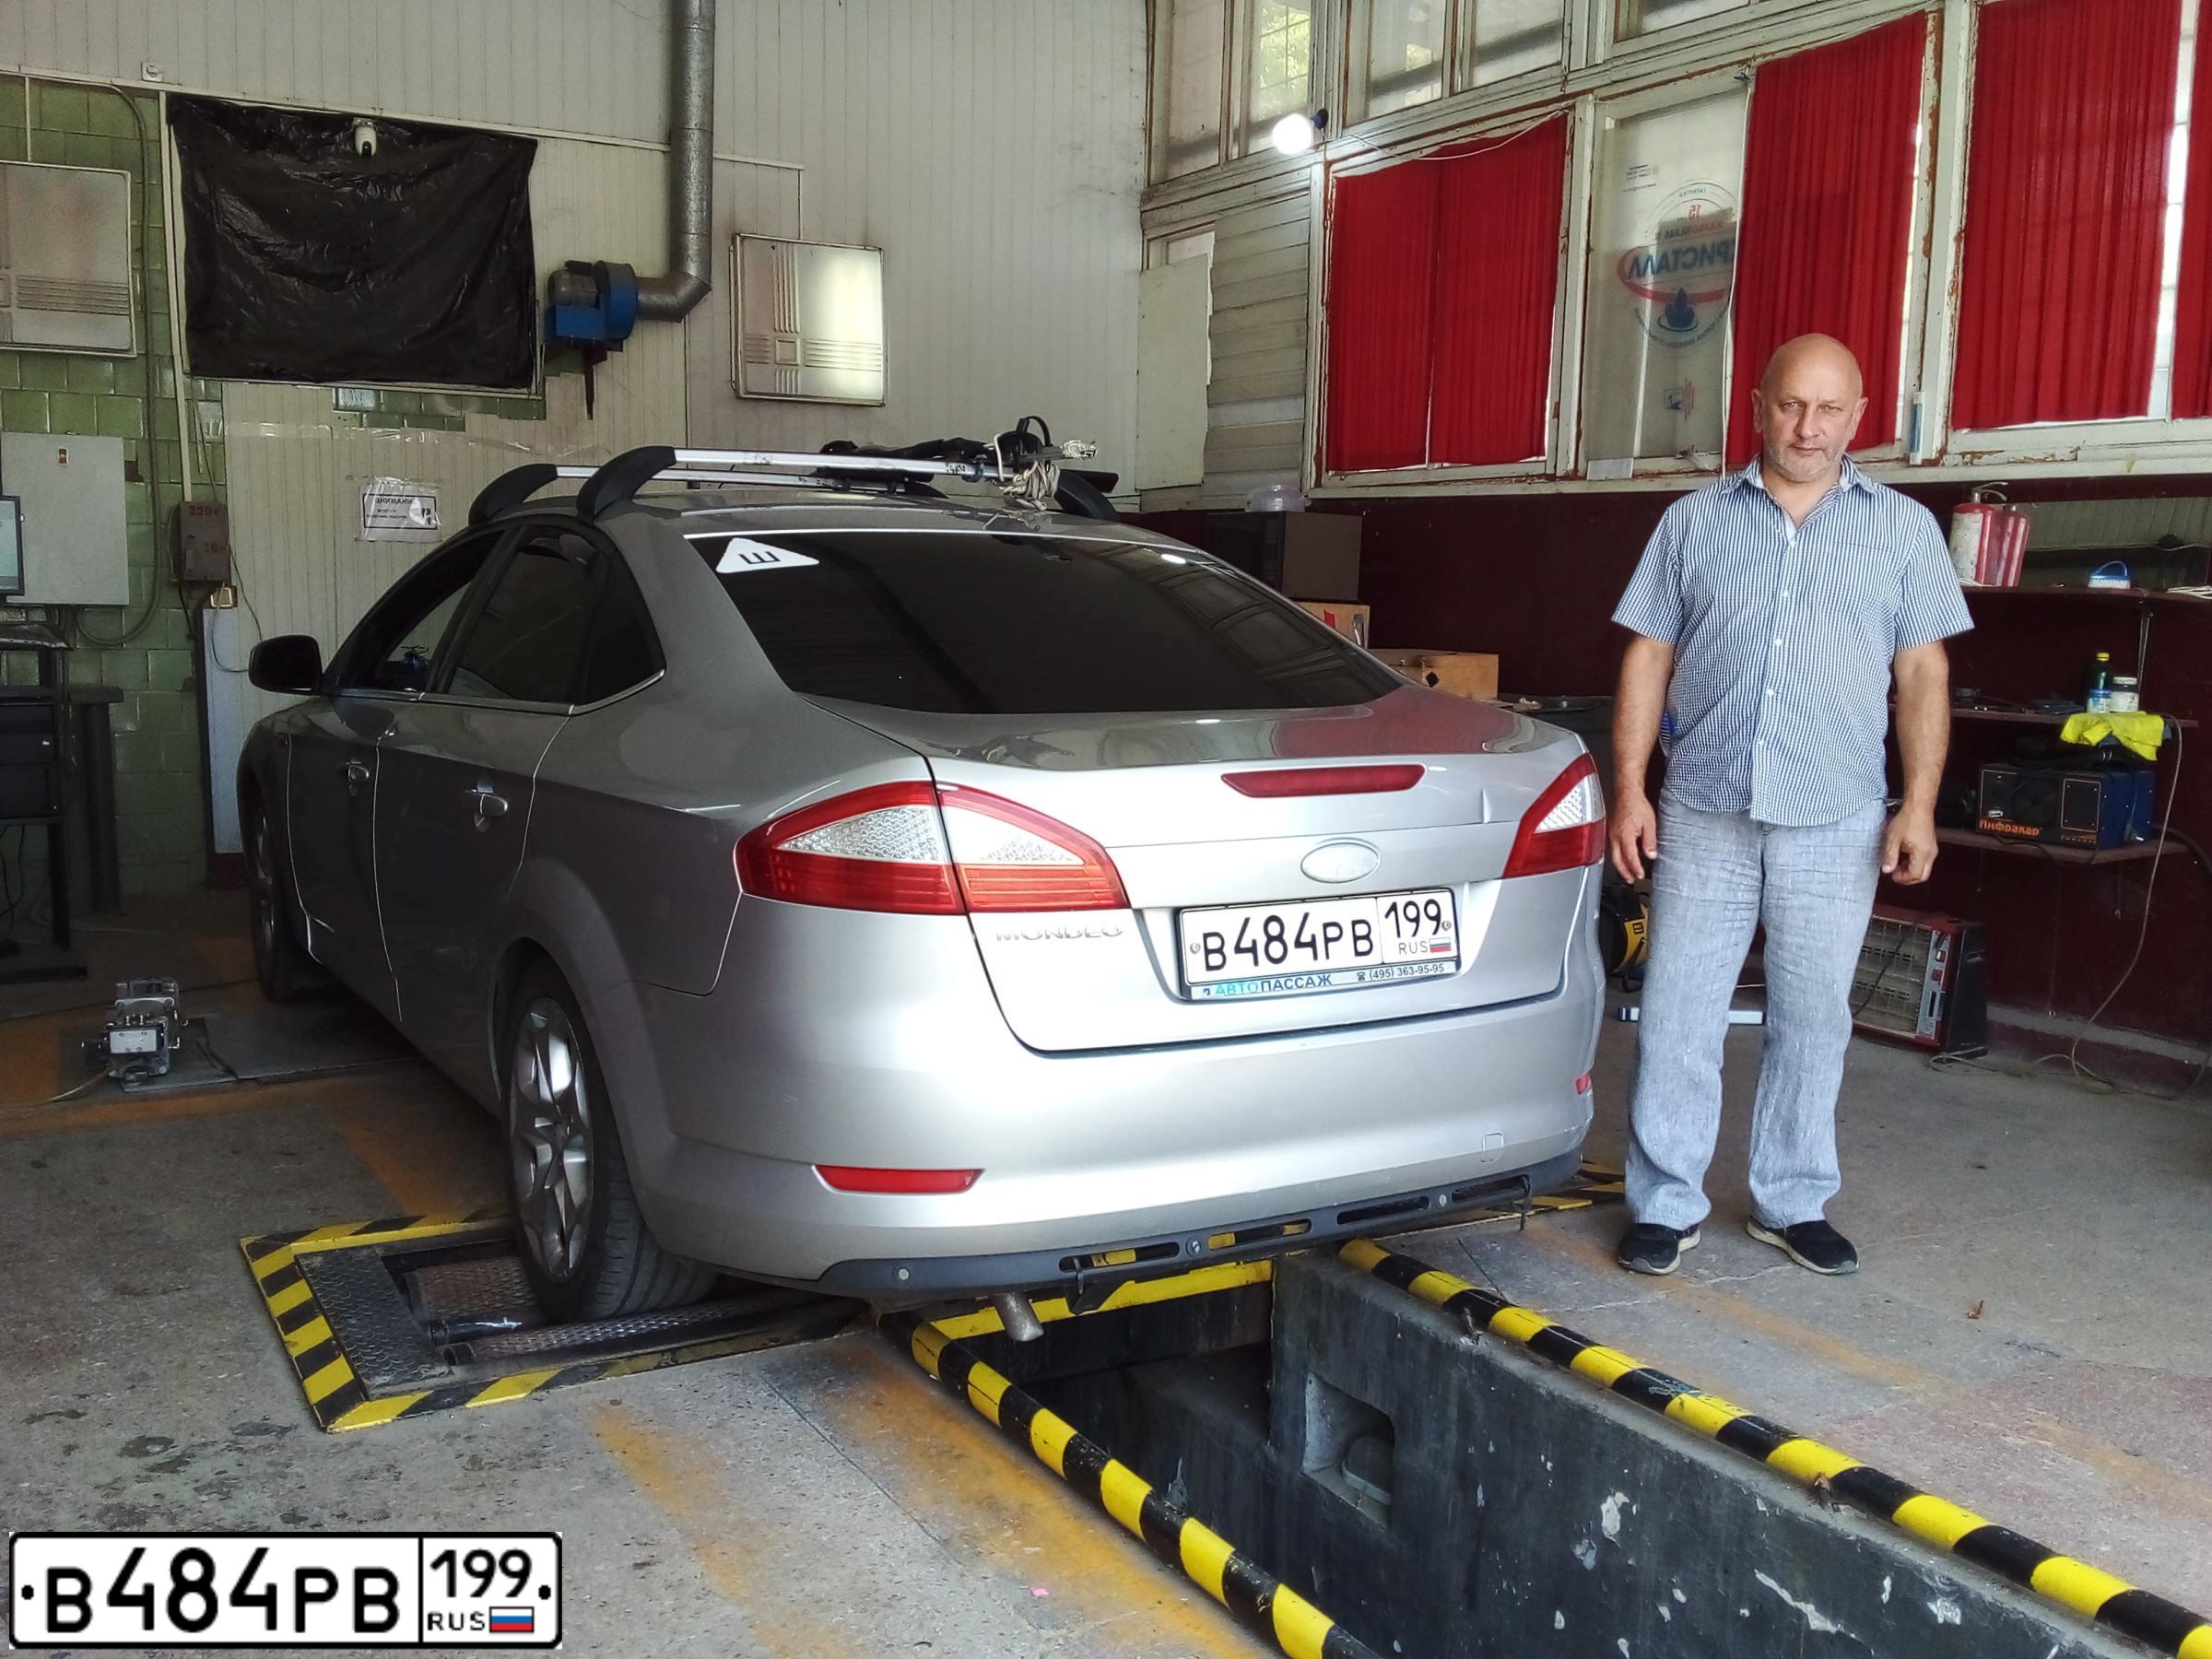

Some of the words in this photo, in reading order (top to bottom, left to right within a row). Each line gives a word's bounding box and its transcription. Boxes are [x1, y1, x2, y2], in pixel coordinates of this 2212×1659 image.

[1979, 818, 2040, 836] Инфракар
[1384, 899, 1442, 938] 199
[1399, 941, 1429, 955] RUS
[1369, 967, 1394, 981] (495)
[1396, 963, 1444, 977] 363-95-95
[1215, 973, 1332, 996] АВТОПАССАЖ
